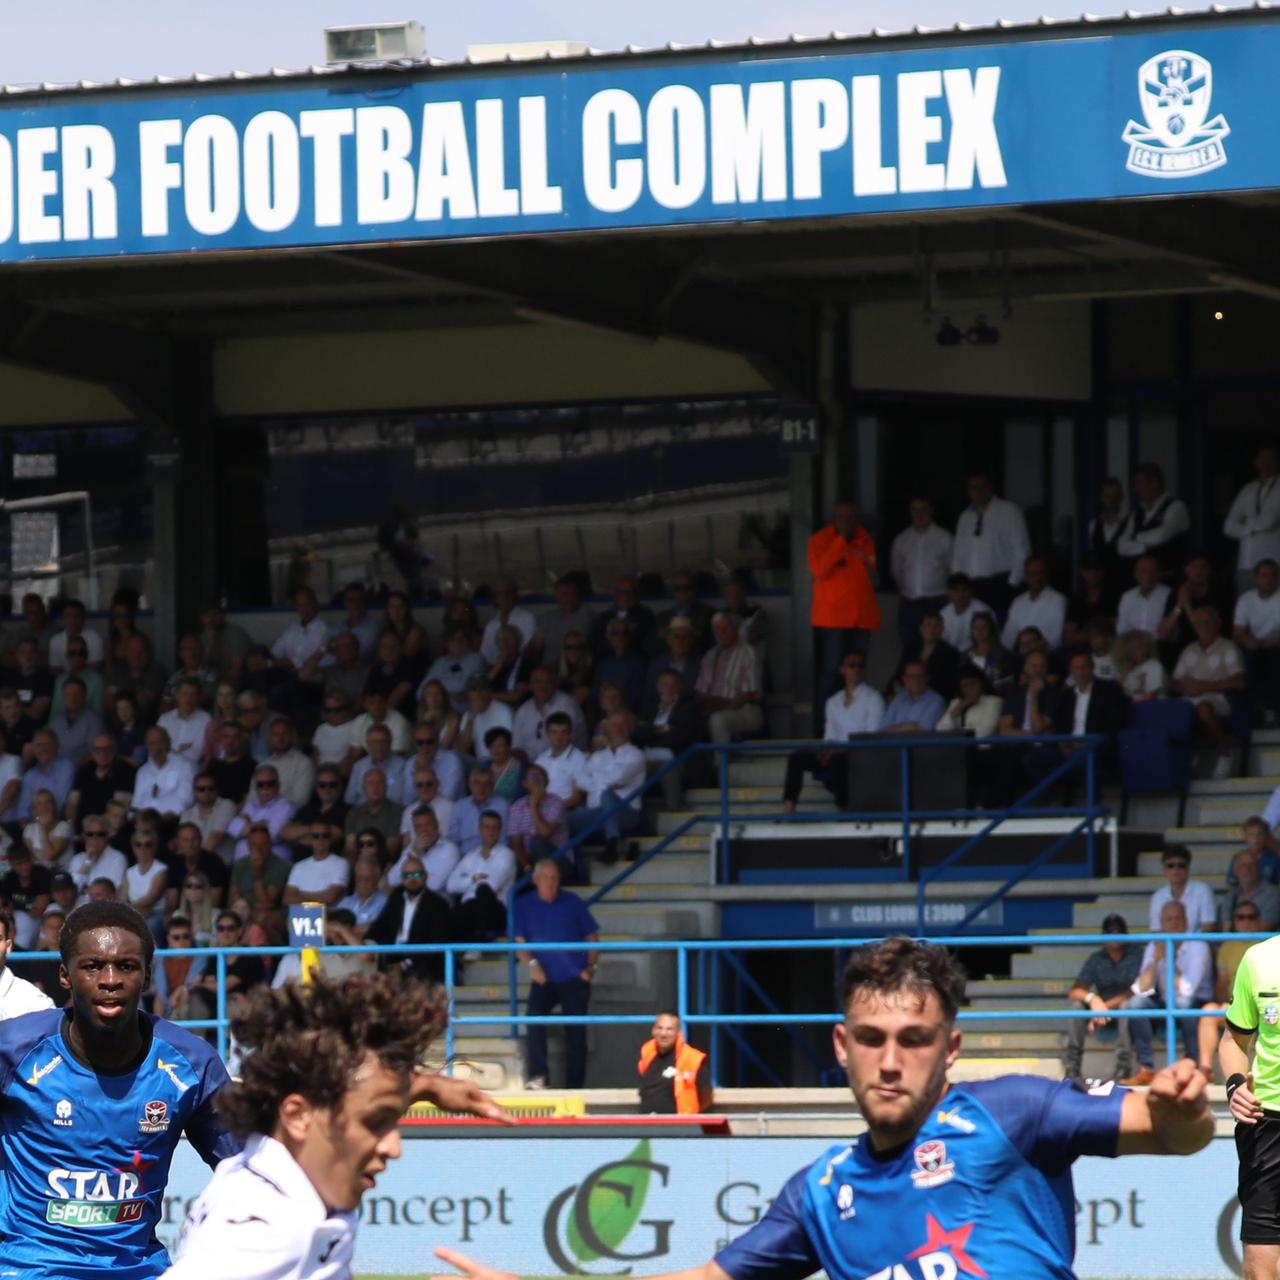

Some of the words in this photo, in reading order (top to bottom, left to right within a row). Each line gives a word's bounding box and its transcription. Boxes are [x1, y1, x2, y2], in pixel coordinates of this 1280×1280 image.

[139, 95, 563, 237] FOOTBALL
[582, 72, 1008, 213] COMPLEX
[782, 419, 816, 441] B1-1
[885, 905, 929, 922] LOUNE
[292, 917, 324, 937] V1.1
[45, 1168, 139, 1201] STAR
[51, 1202, 115, 1224] SPORT
[122, 1202, 142, 1219] TV
[358, 1187, 513, 1242] ncept
